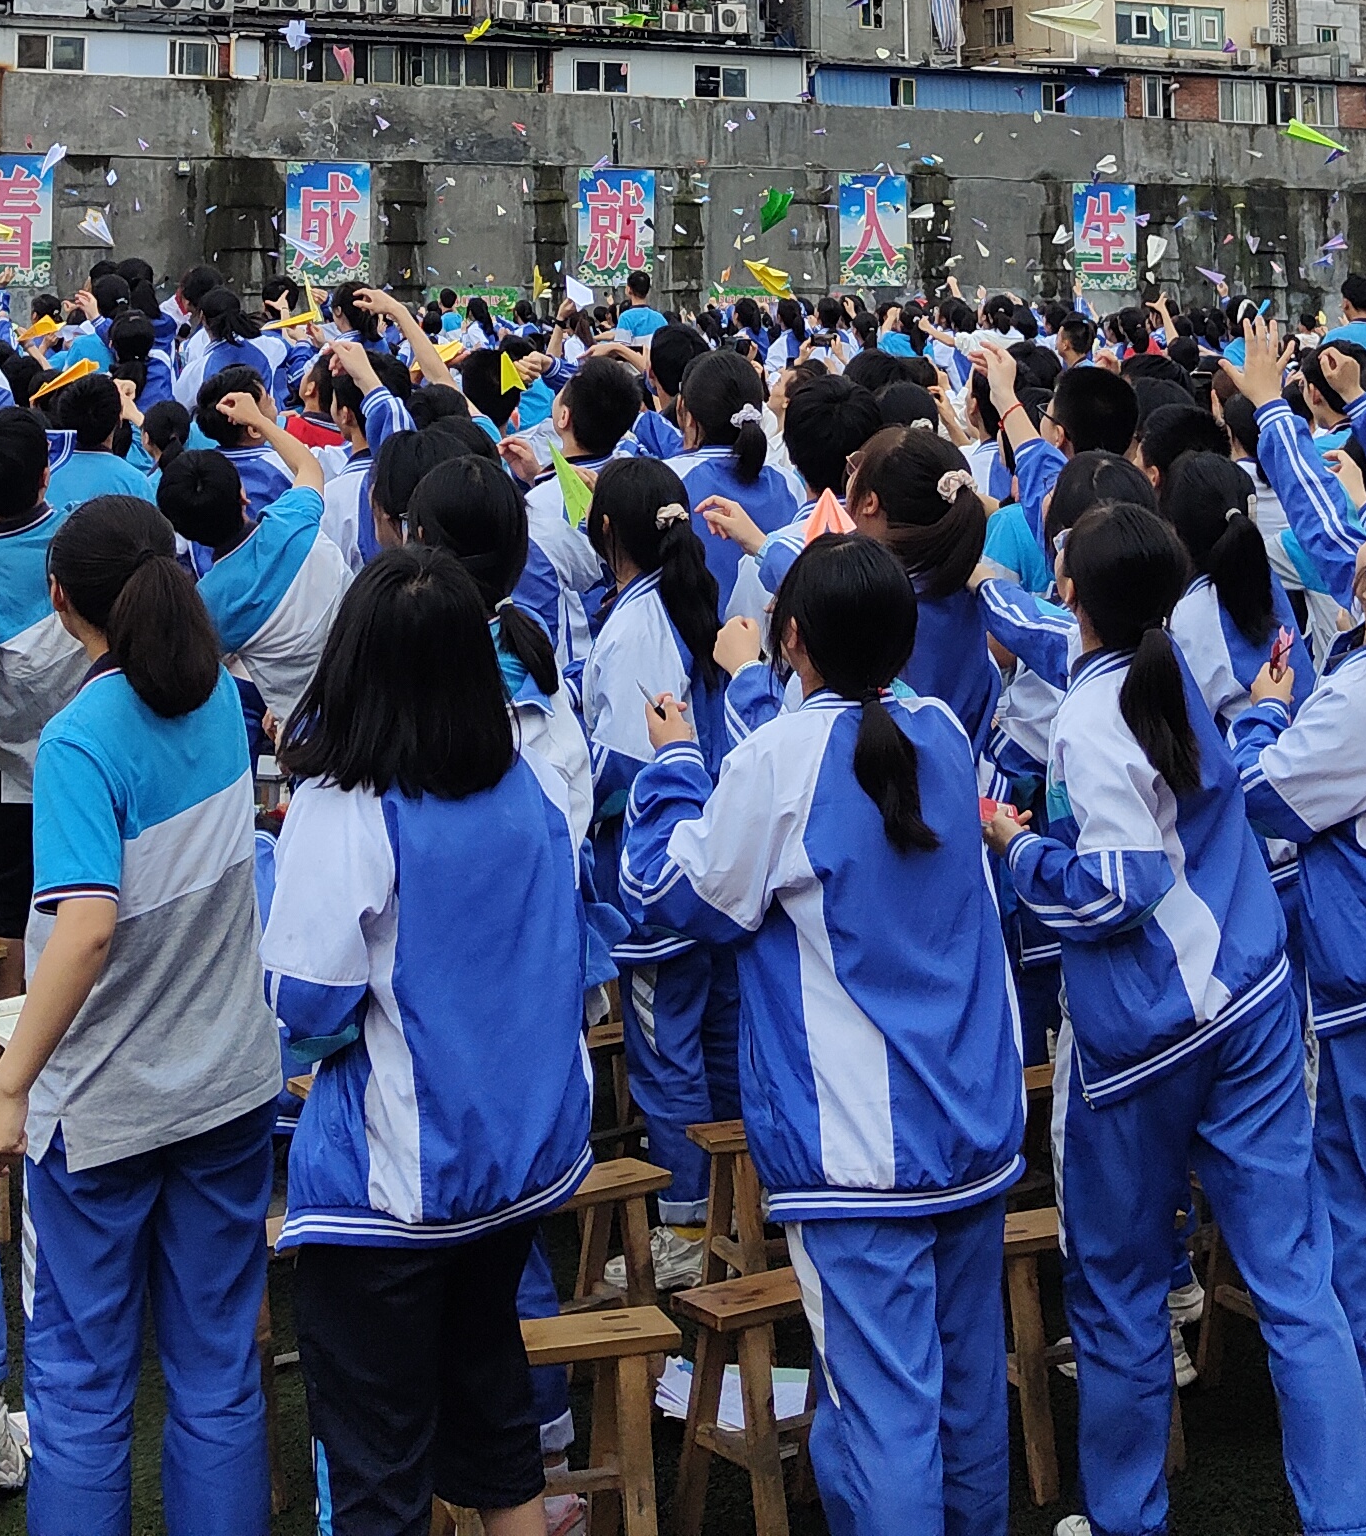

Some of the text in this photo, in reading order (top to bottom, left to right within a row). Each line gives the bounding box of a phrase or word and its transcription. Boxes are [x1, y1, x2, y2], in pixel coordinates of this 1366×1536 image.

[293, 172, 363, 269] 成
[584, 179, 646, 270] 就
[846, 187, 899, 269] 人
[1081, 192, 1131, 273] 生
